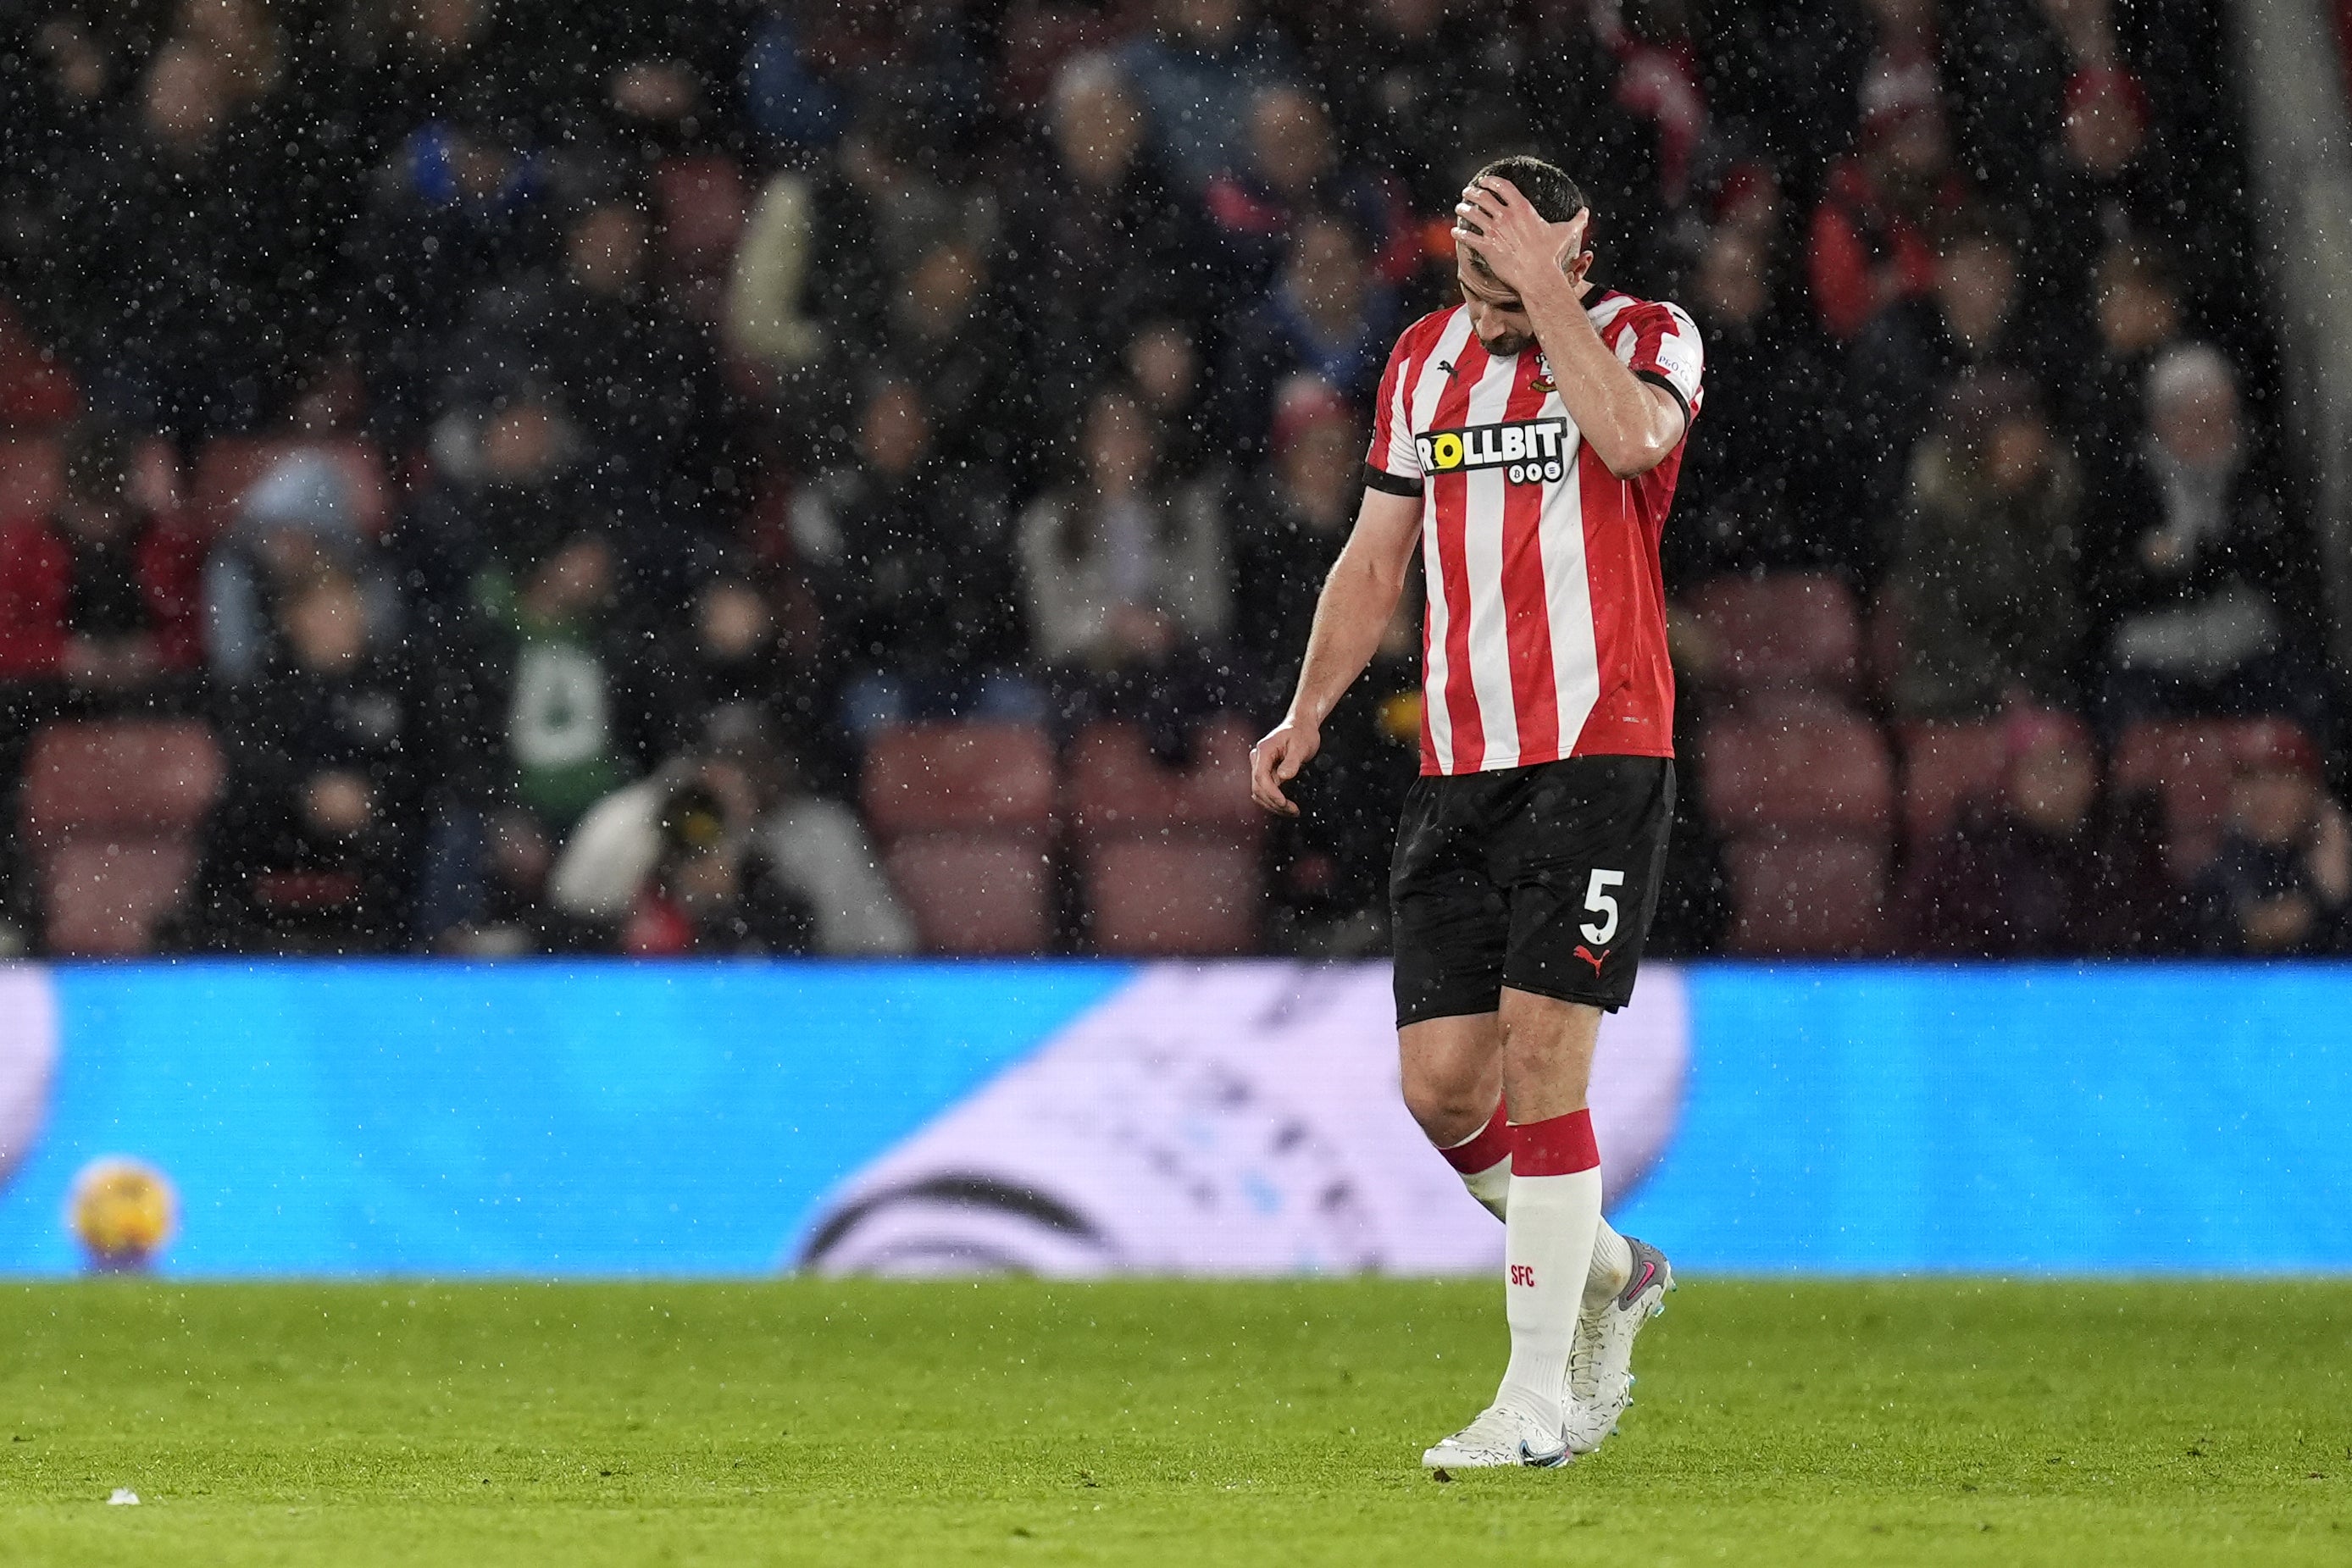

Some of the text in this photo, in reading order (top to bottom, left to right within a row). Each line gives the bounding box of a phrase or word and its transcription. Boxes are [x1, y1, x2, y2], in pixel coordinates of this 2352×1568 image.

[1416, 422, 1562, 471] ROLLBIT
[1579, 868, 1625, 945] 5
[1511, 1265, 1534, 1287] SFC
